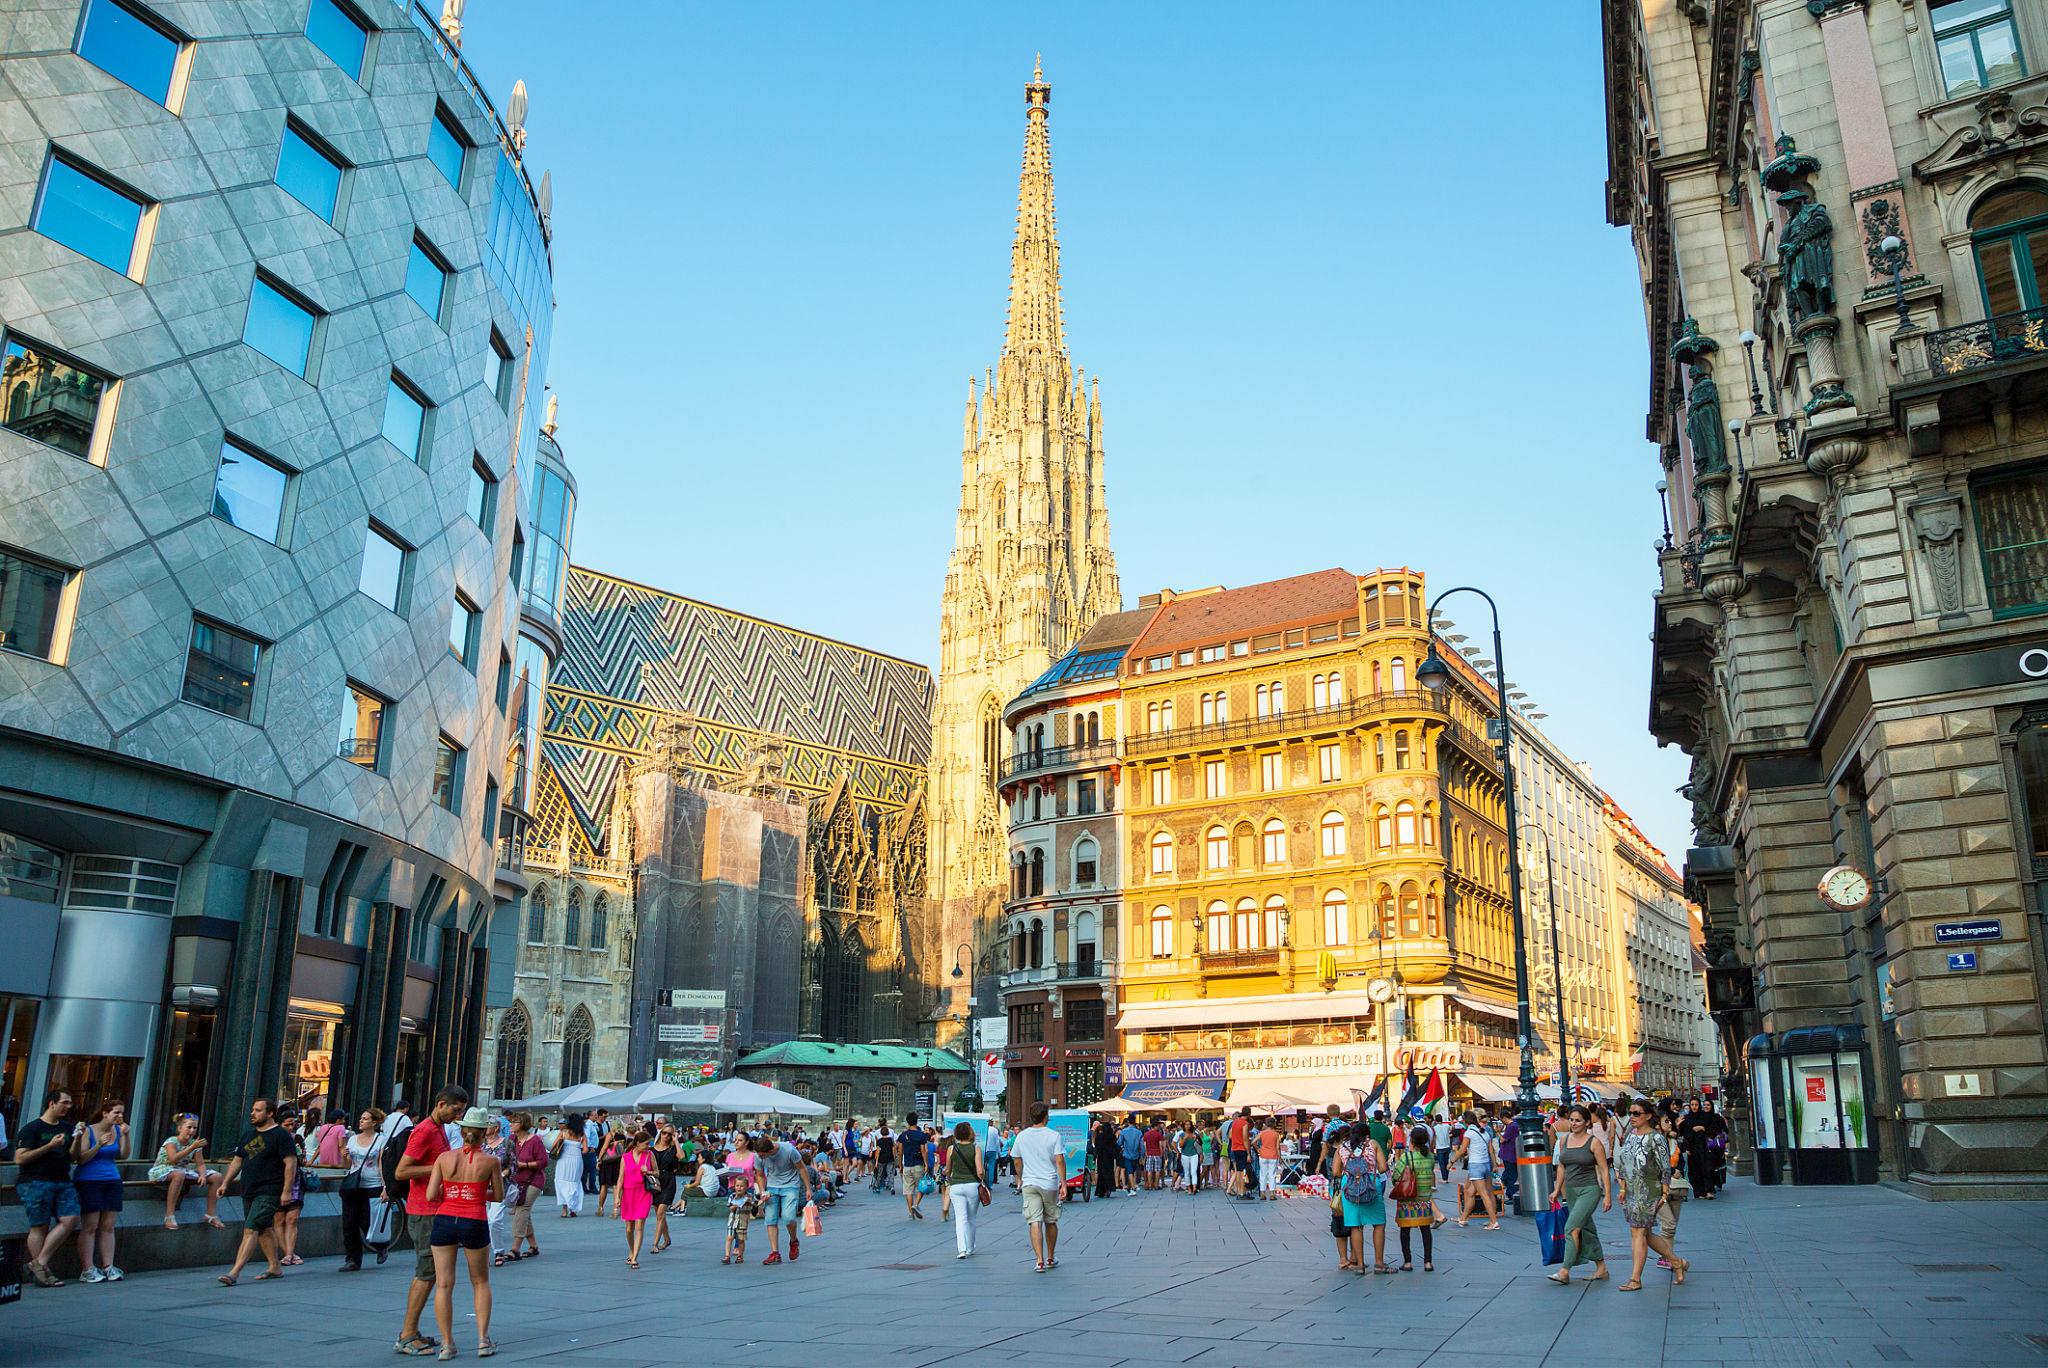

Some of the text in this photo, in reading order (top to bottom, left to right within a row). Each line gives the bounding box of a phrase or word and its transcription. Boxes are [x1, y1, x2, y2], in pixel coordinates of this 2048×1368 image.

[1956, 954, 1966, 965] 1
[1278, 1052, 1379, 1069] KONDITOREI
[1105, 1065, 1123, 1074] CHANGE
[1125, 1060, 1226, 1080] MONEY EXCHANGE
